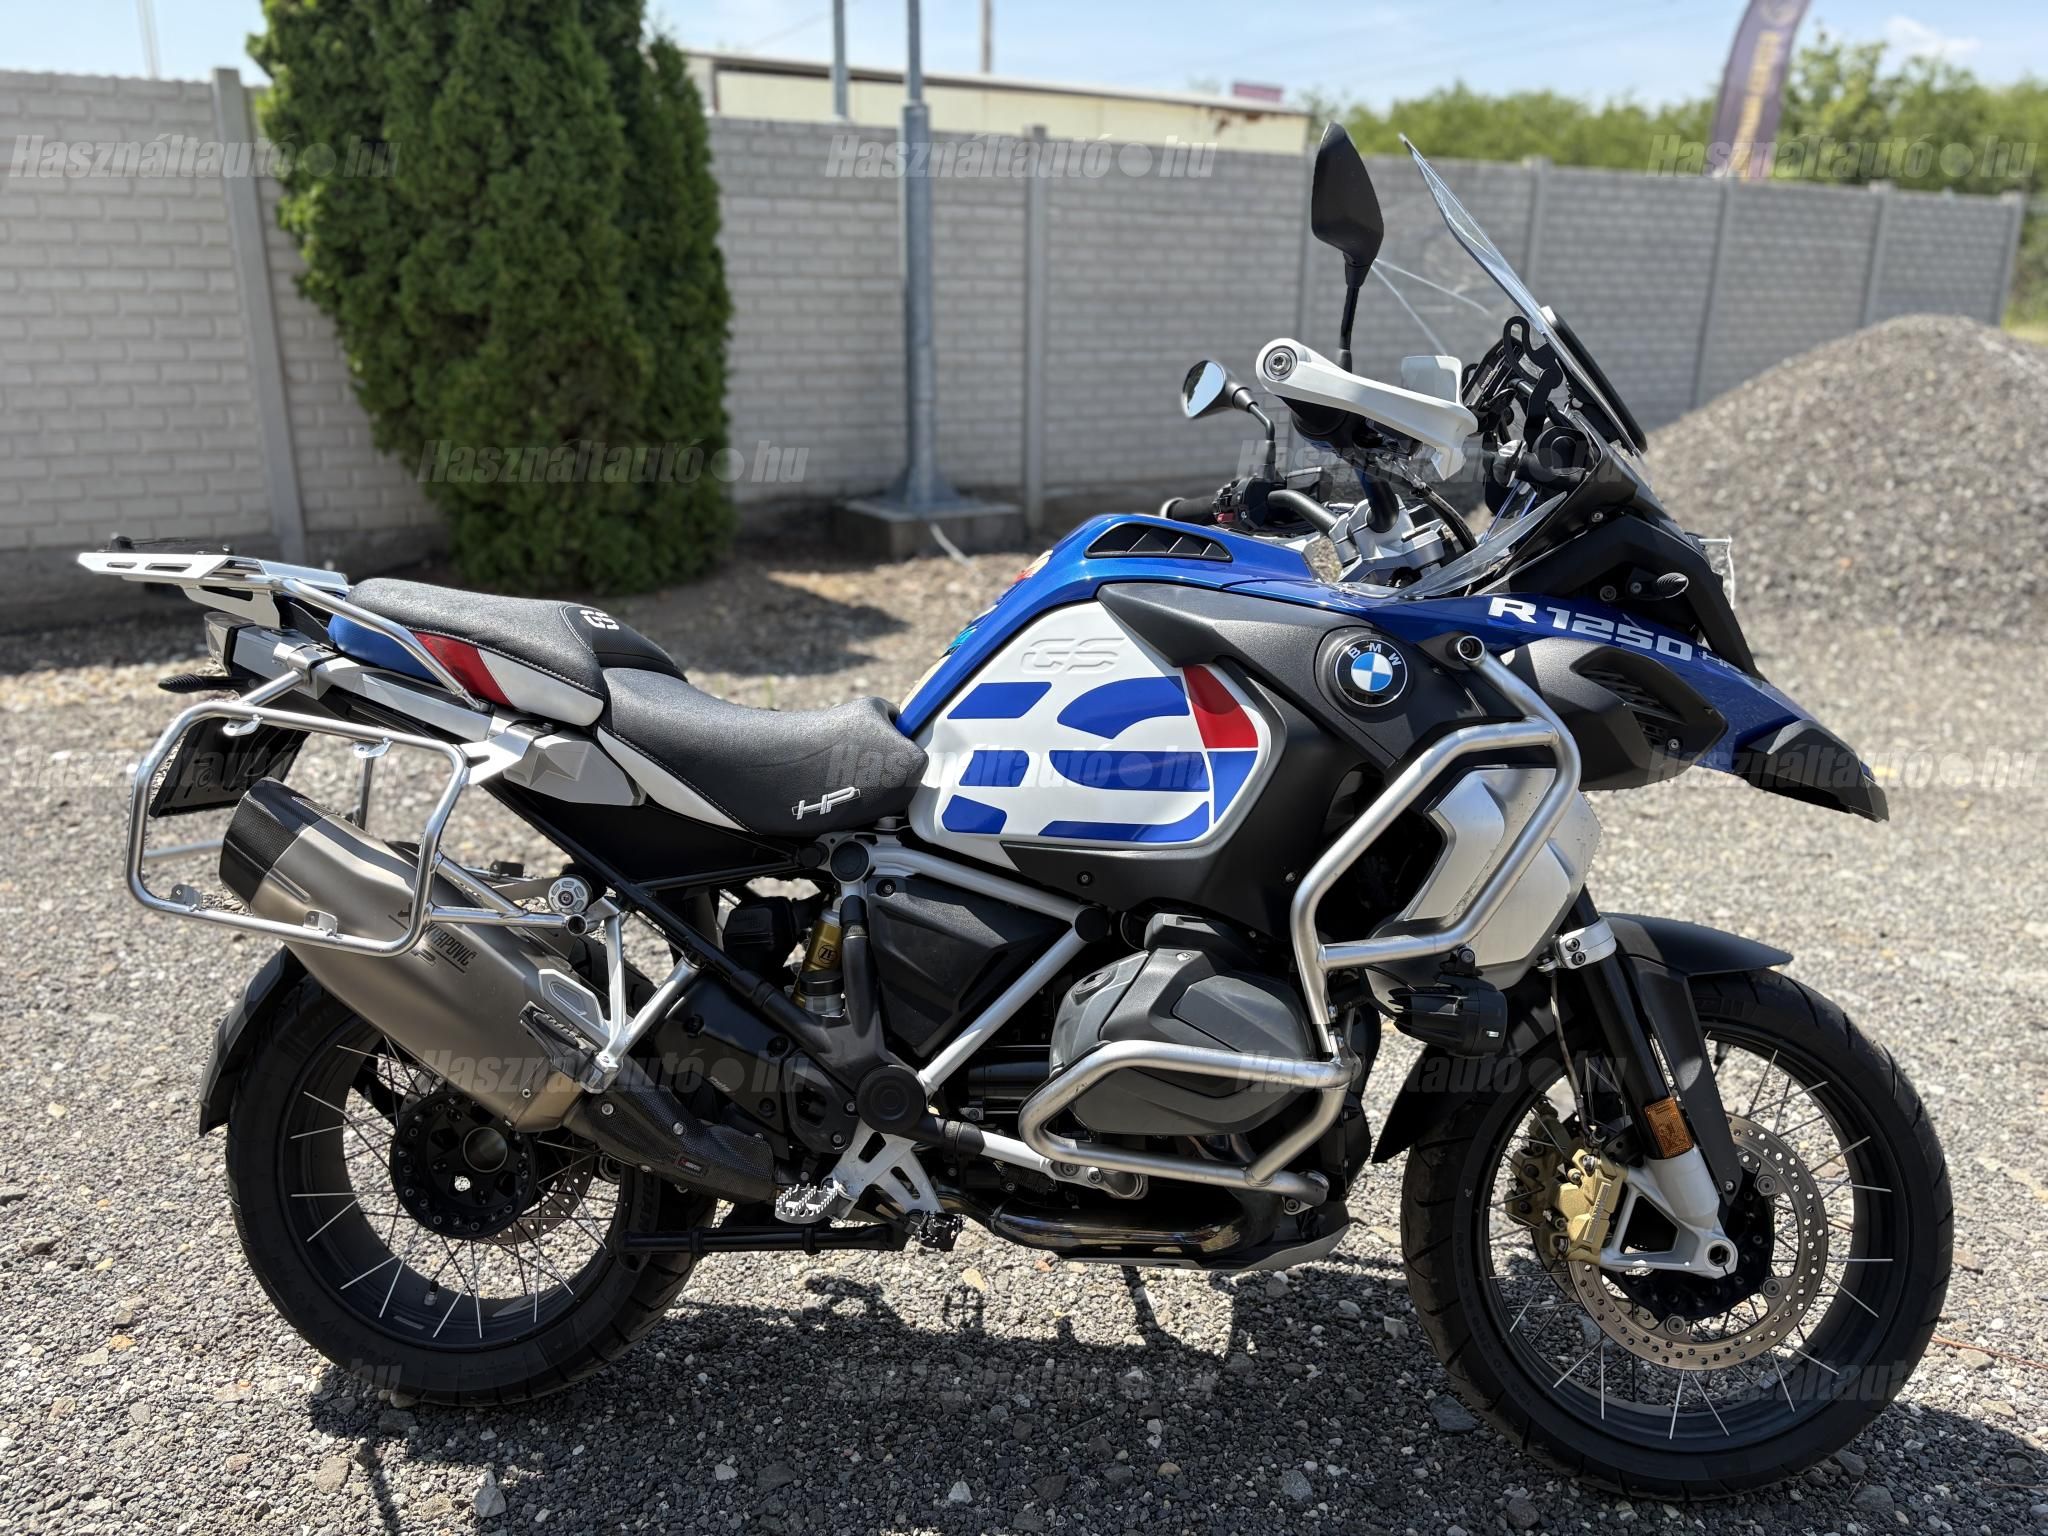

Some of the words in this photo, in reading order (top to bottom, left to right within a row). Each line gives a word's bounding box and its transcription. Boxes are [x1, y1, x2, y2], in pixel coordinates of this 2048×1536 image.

[1488, 597, 1537, 624] R
[1546, 606, 1693, 662] 1250
[1019, 637, 1127, 675] GS
[1347, 642, 1402, 666] BMW
[791, 786, 861, 820] HP
[422, 922, 478, 968] KRAPOVIČ
